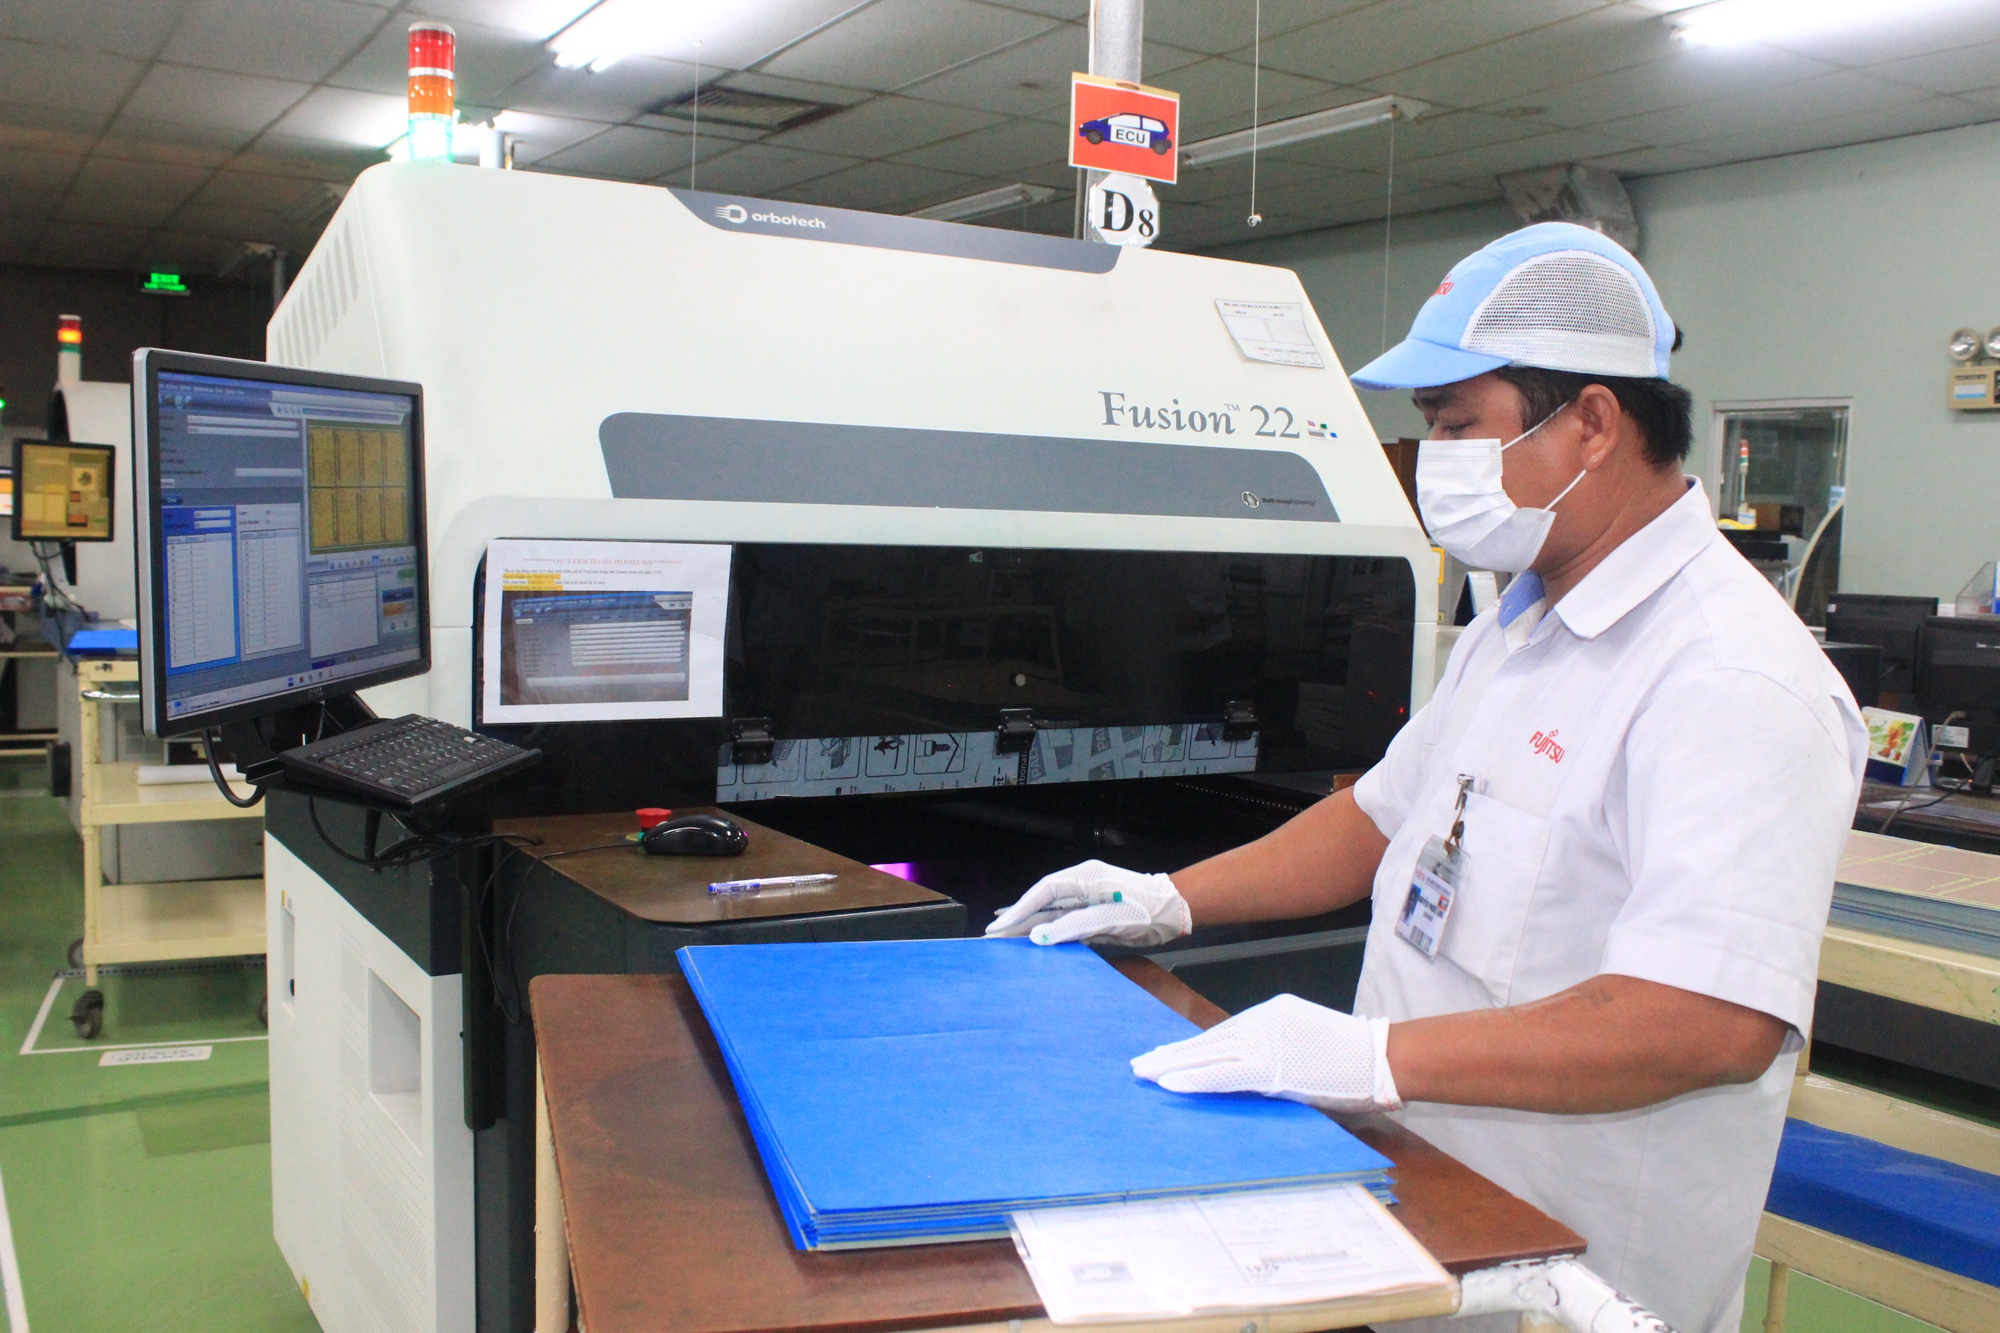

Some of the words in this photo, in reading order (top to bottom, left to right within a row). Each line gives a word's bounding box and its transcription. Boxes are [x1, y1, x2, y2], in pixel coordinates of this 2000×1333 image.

[1115, 129, 1146, 144] ECU
[751, 203, 827, 229] orbotech
[1249, 404, 1301, 439] 22
[1529, 730, 1566, 764] FUJITSU
